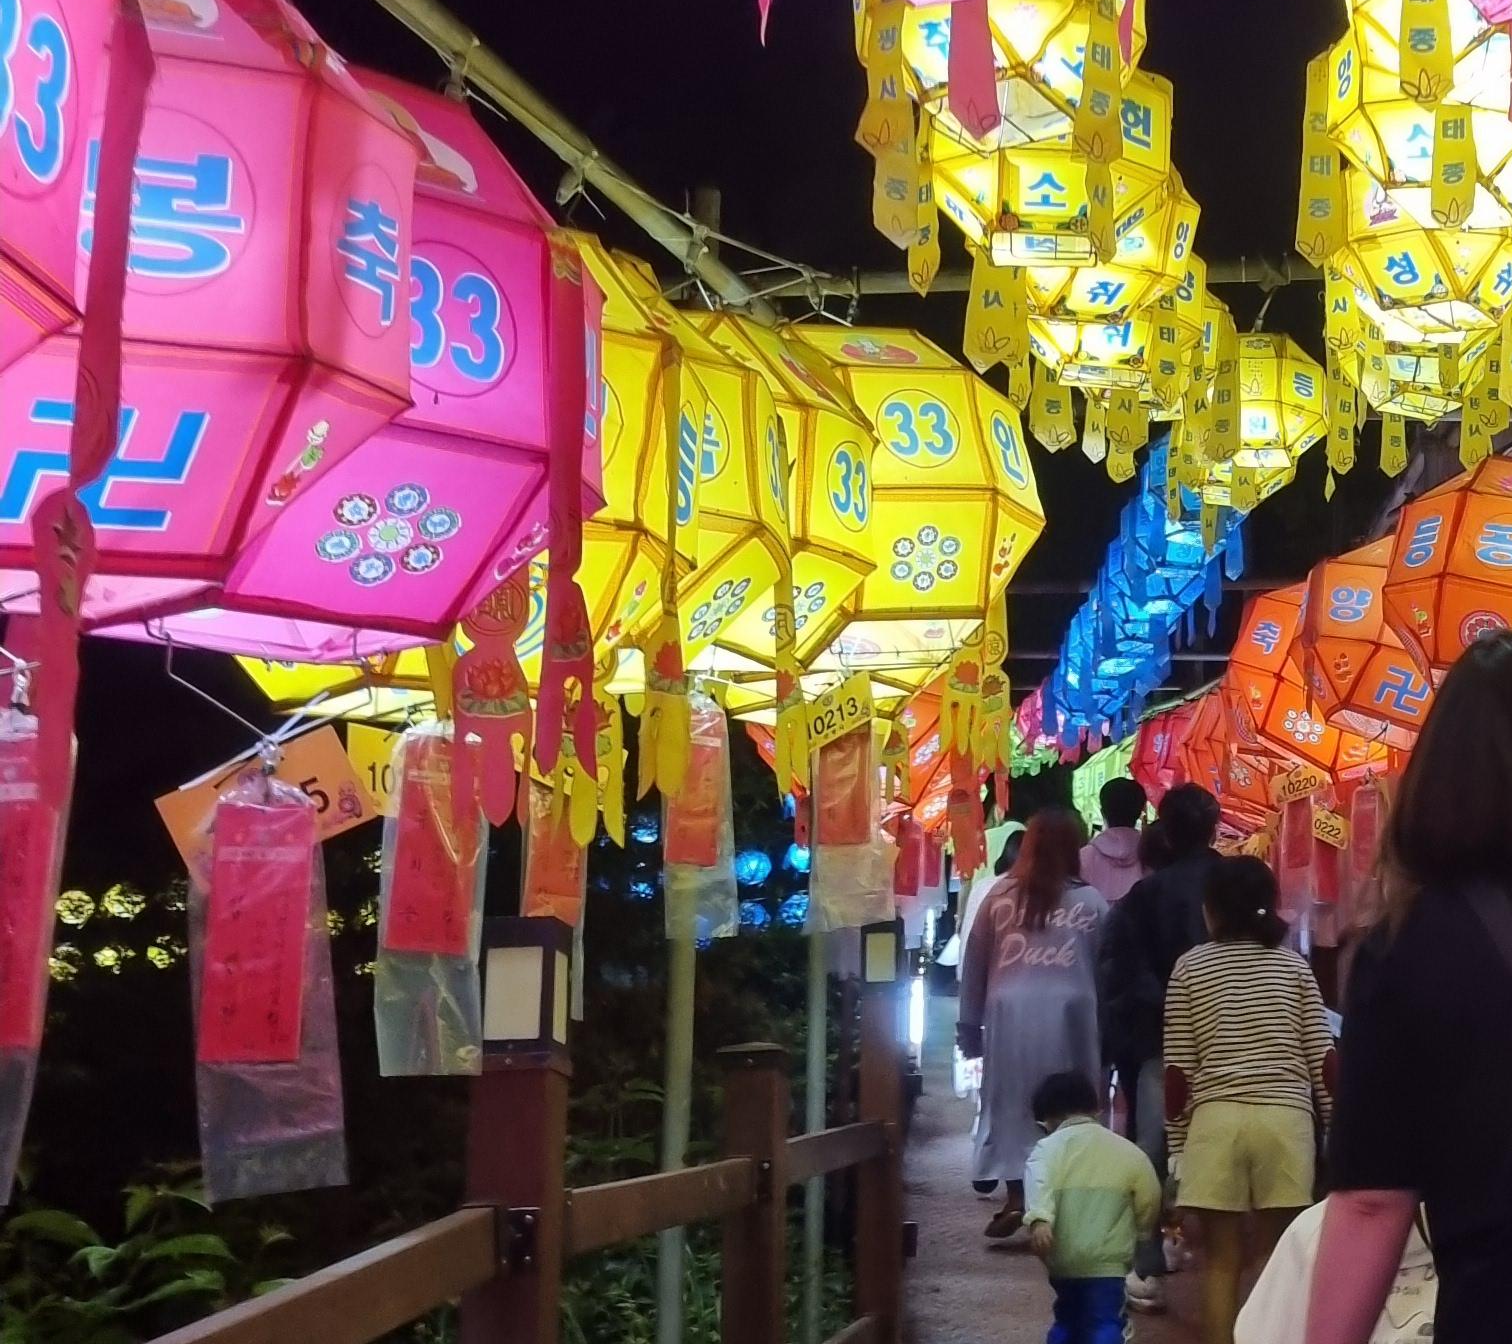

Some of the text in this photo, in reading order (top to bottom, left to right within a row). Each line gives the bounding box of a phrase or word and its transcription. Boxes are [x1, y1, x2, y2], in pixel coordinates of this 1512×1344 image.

[1023, 171, 1068, 209] 소
[410, 257, 505, 382] 33
[882, 400, 956, 457] 33
[831, 449, 868, 532] 33
[807, 696, 859, 741] 10213
[1281, 774, 1318, 797] 10220
[999, 932, 1079, 969] Duck
